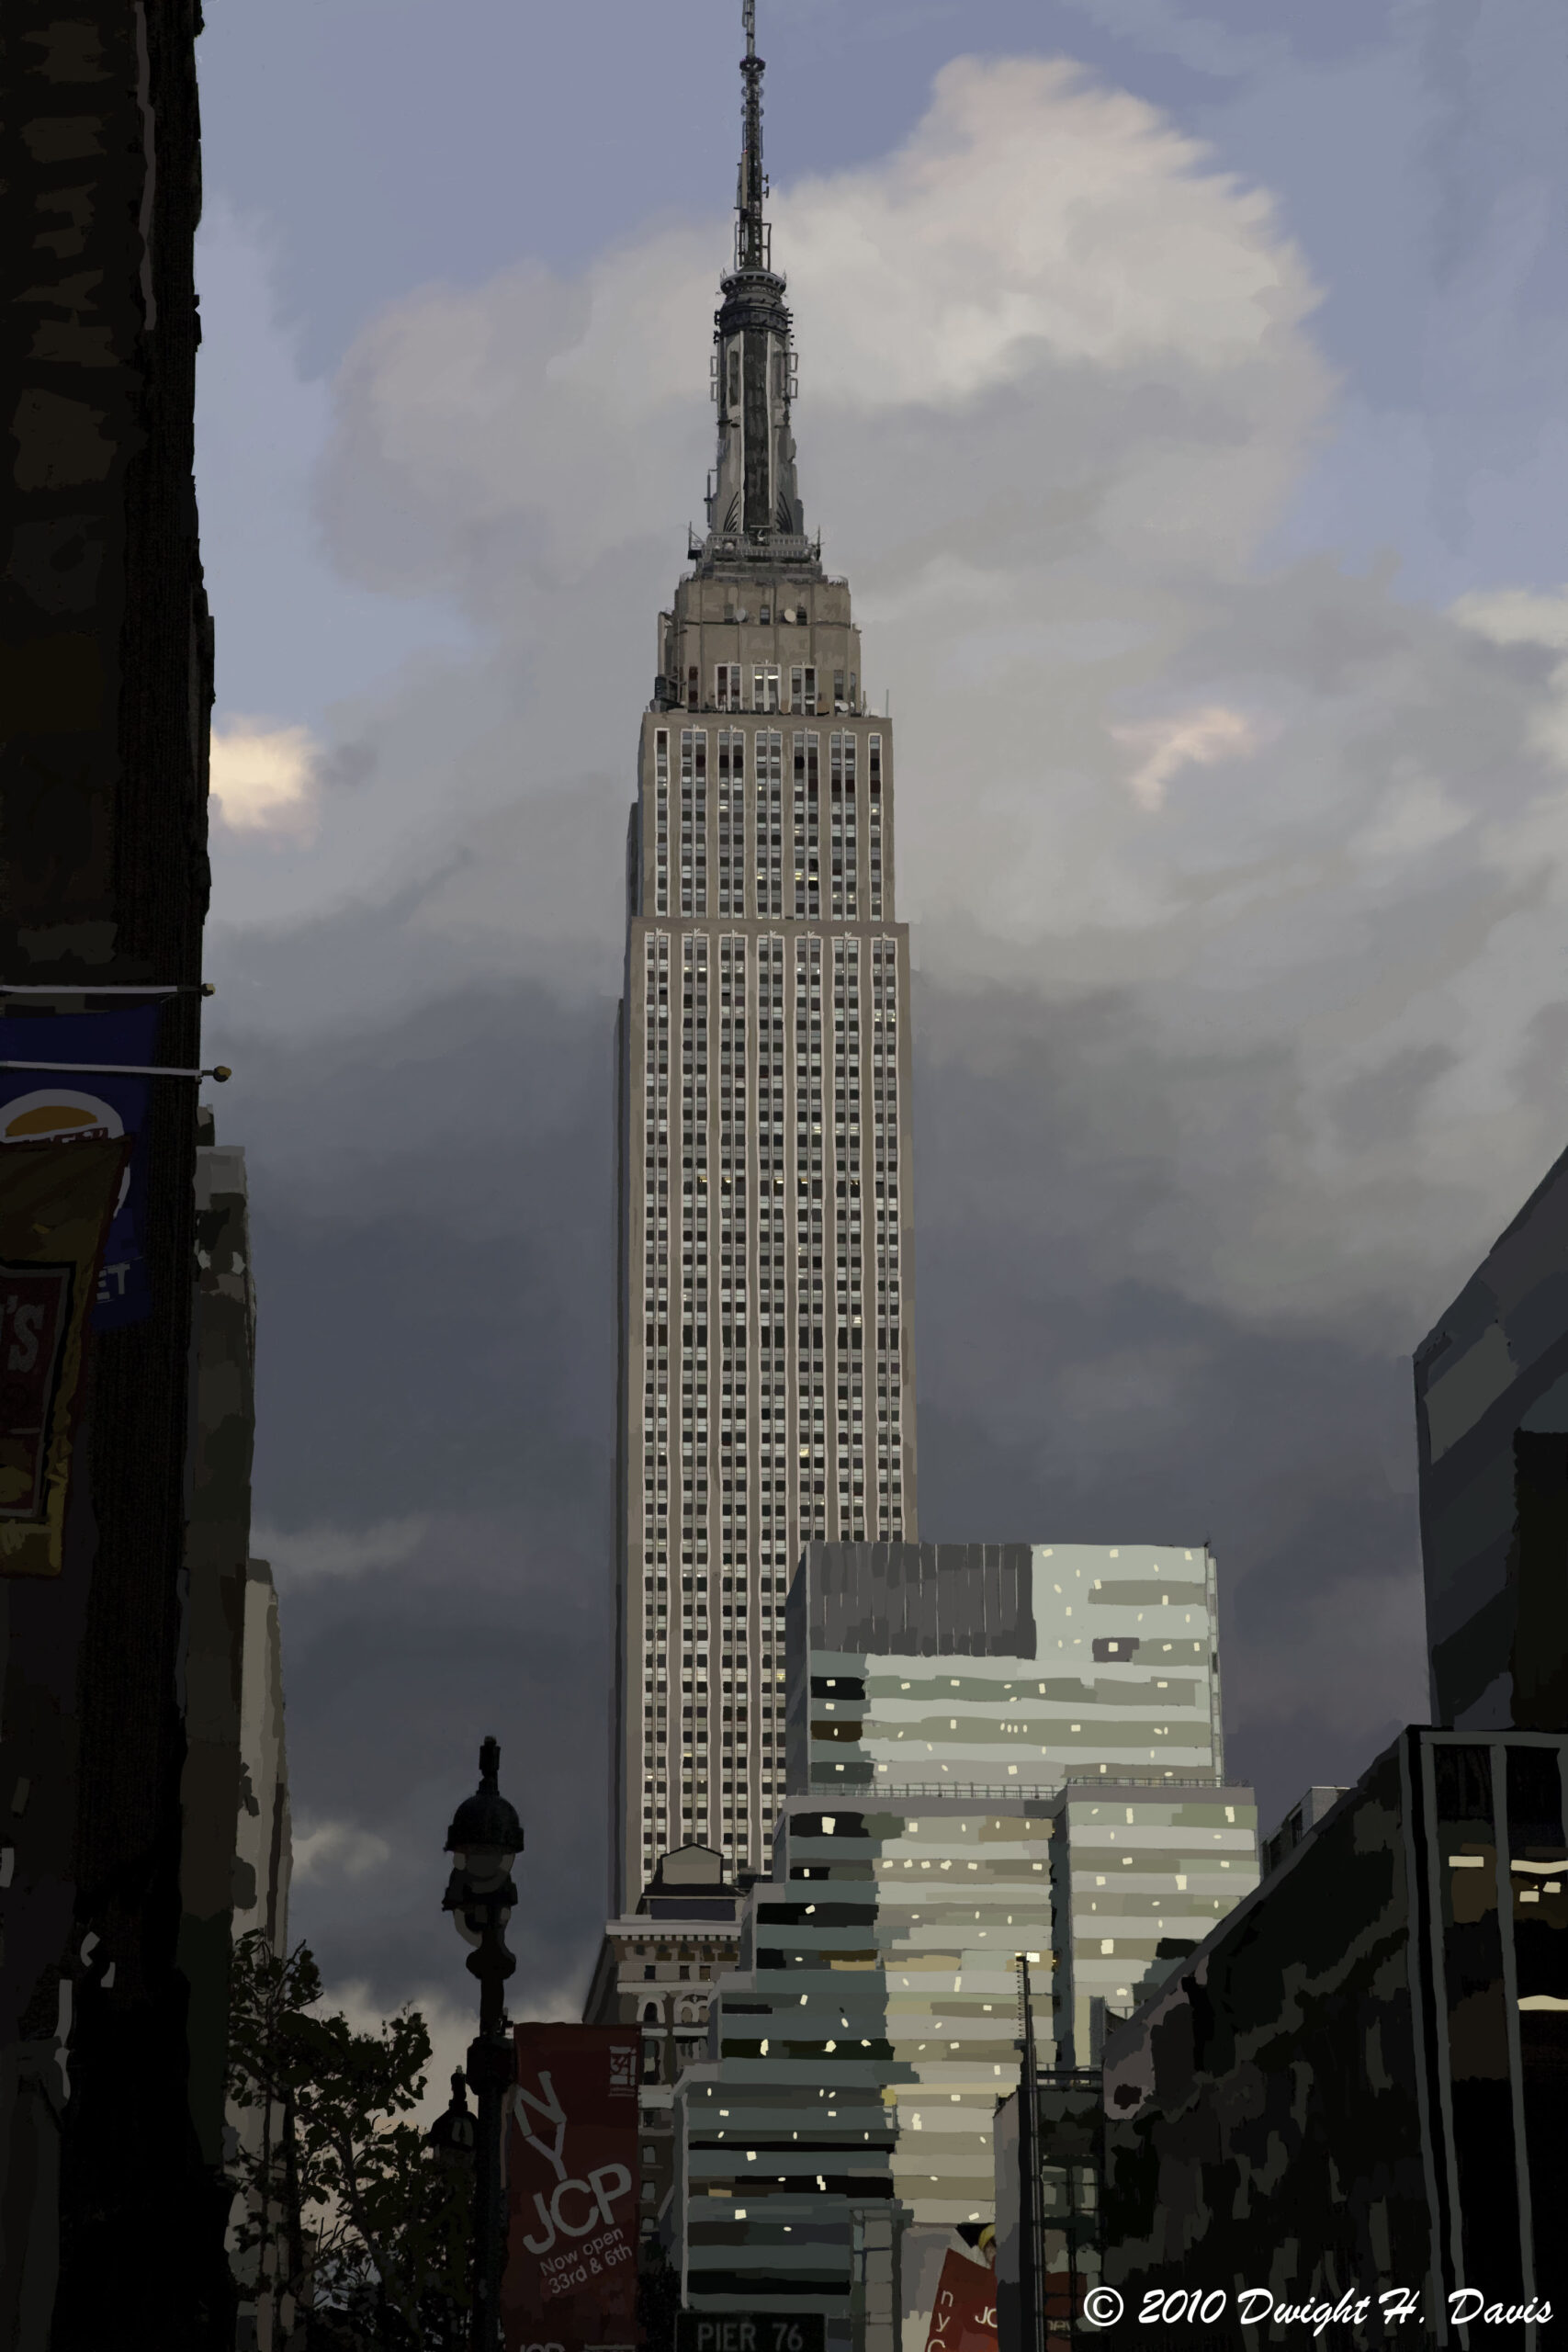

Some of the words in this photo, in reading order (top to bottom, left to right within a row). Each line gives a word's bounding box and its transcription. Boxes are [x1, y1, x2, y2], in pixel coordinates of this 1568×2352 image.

[523, 2163, 632, 2256] JCP
[539, 2250, 579, 2277] Now
[582, 2227, 625, 2256] open
[548, 2265, 588, 2294] 33rd
[590, 2257, 604, 2274] &
[604, 2244, 633, 2267] 6th
[697, 2322, 758, 2352] PIER
[772, 2322, 804, 2352] 76
